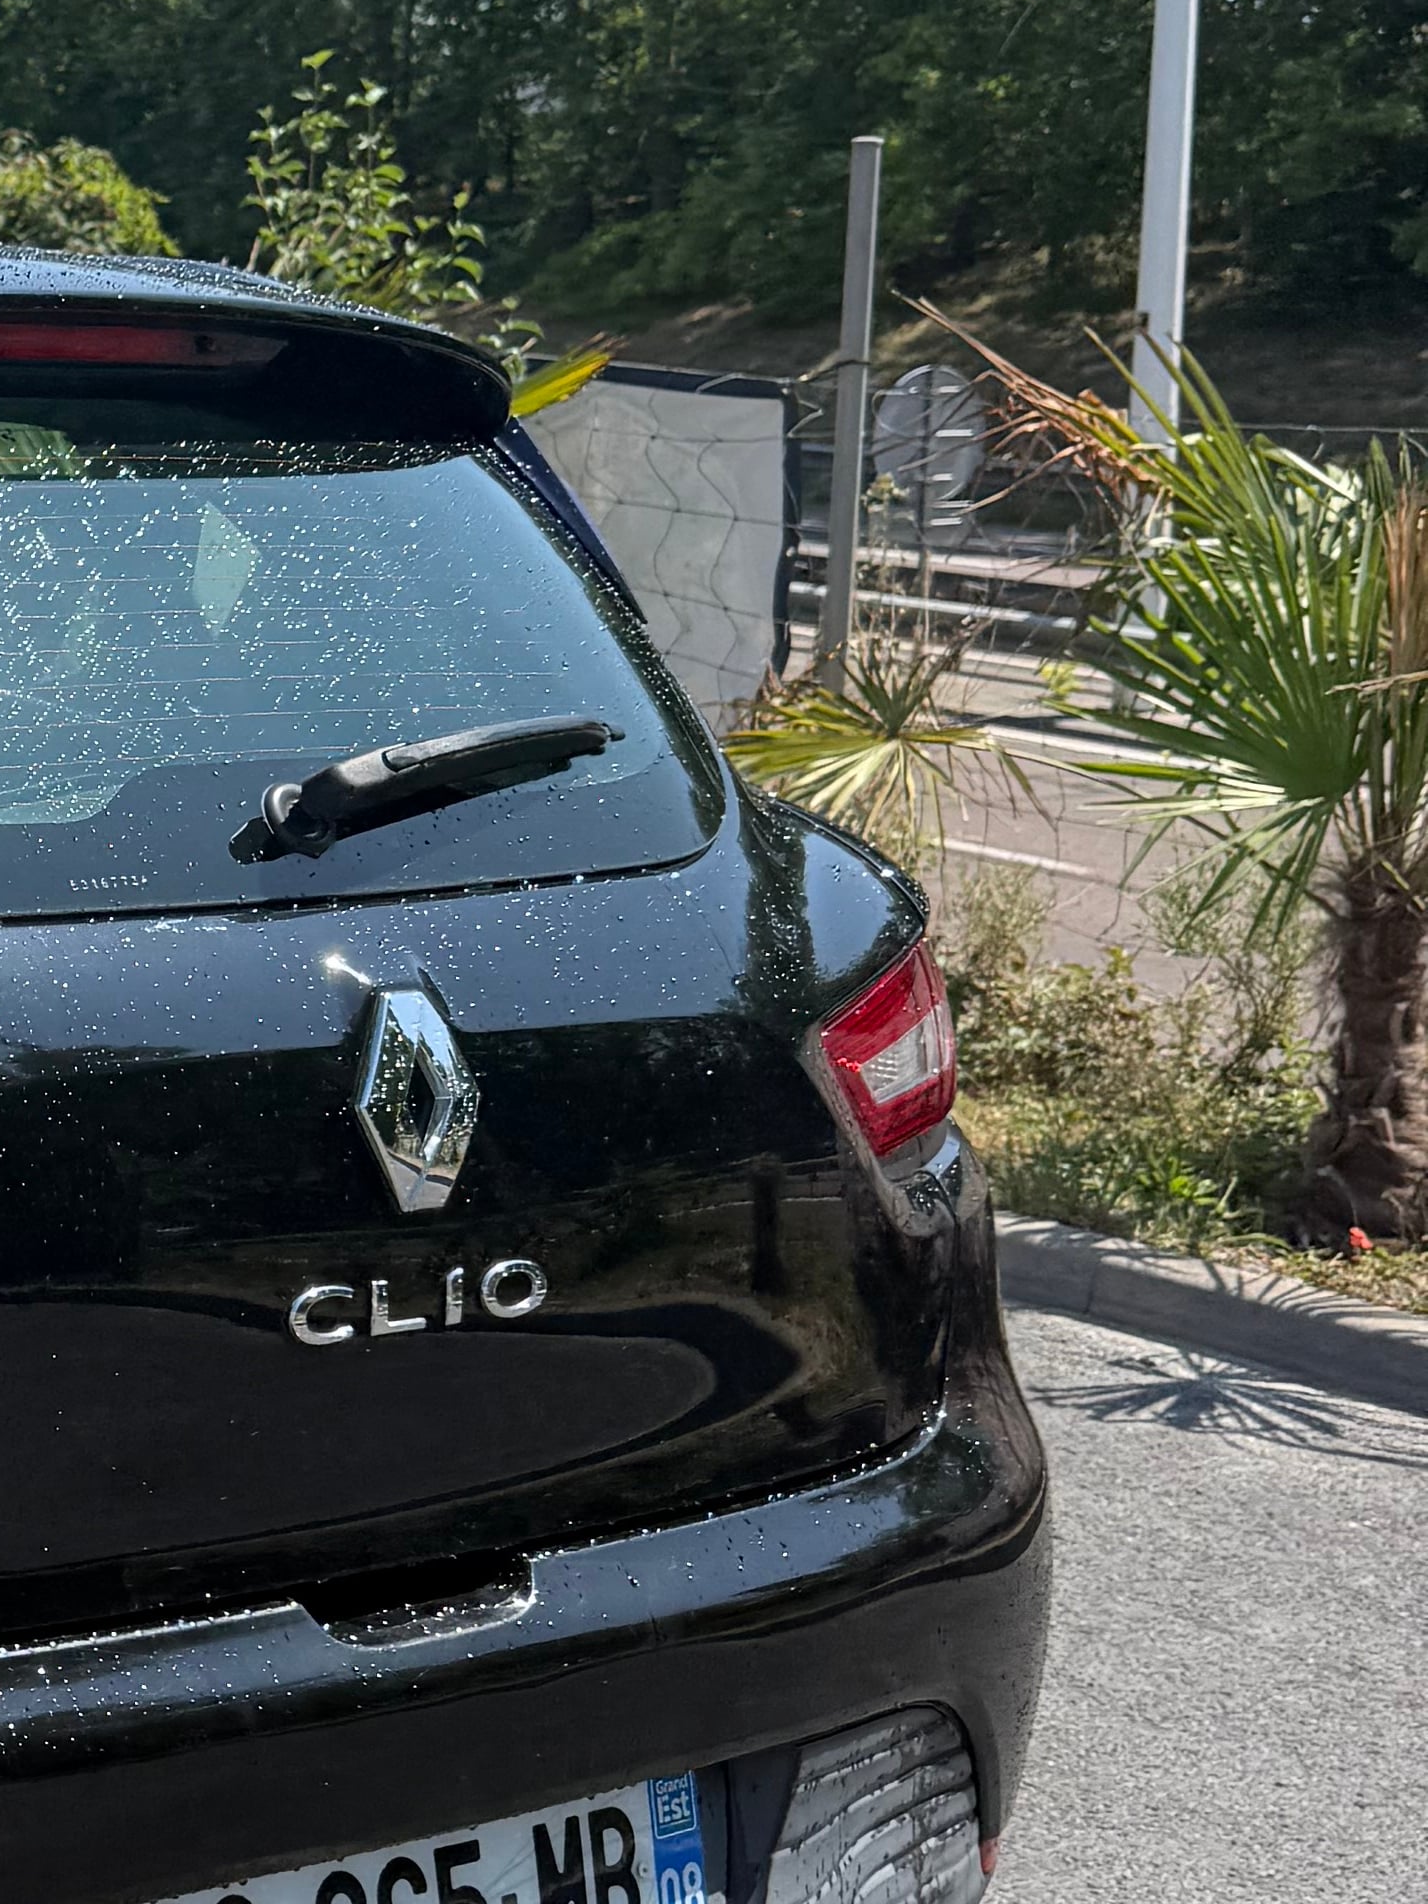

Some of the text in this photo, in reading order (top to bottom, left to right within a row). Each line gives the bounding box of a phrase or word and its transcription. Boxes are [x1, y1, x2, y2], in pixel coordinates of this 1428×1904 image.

[288, 1258, 547, 1346] CLIO
[655, 1773, 690, 1795] Grand
[656, 1790, 691, 1824] Est
